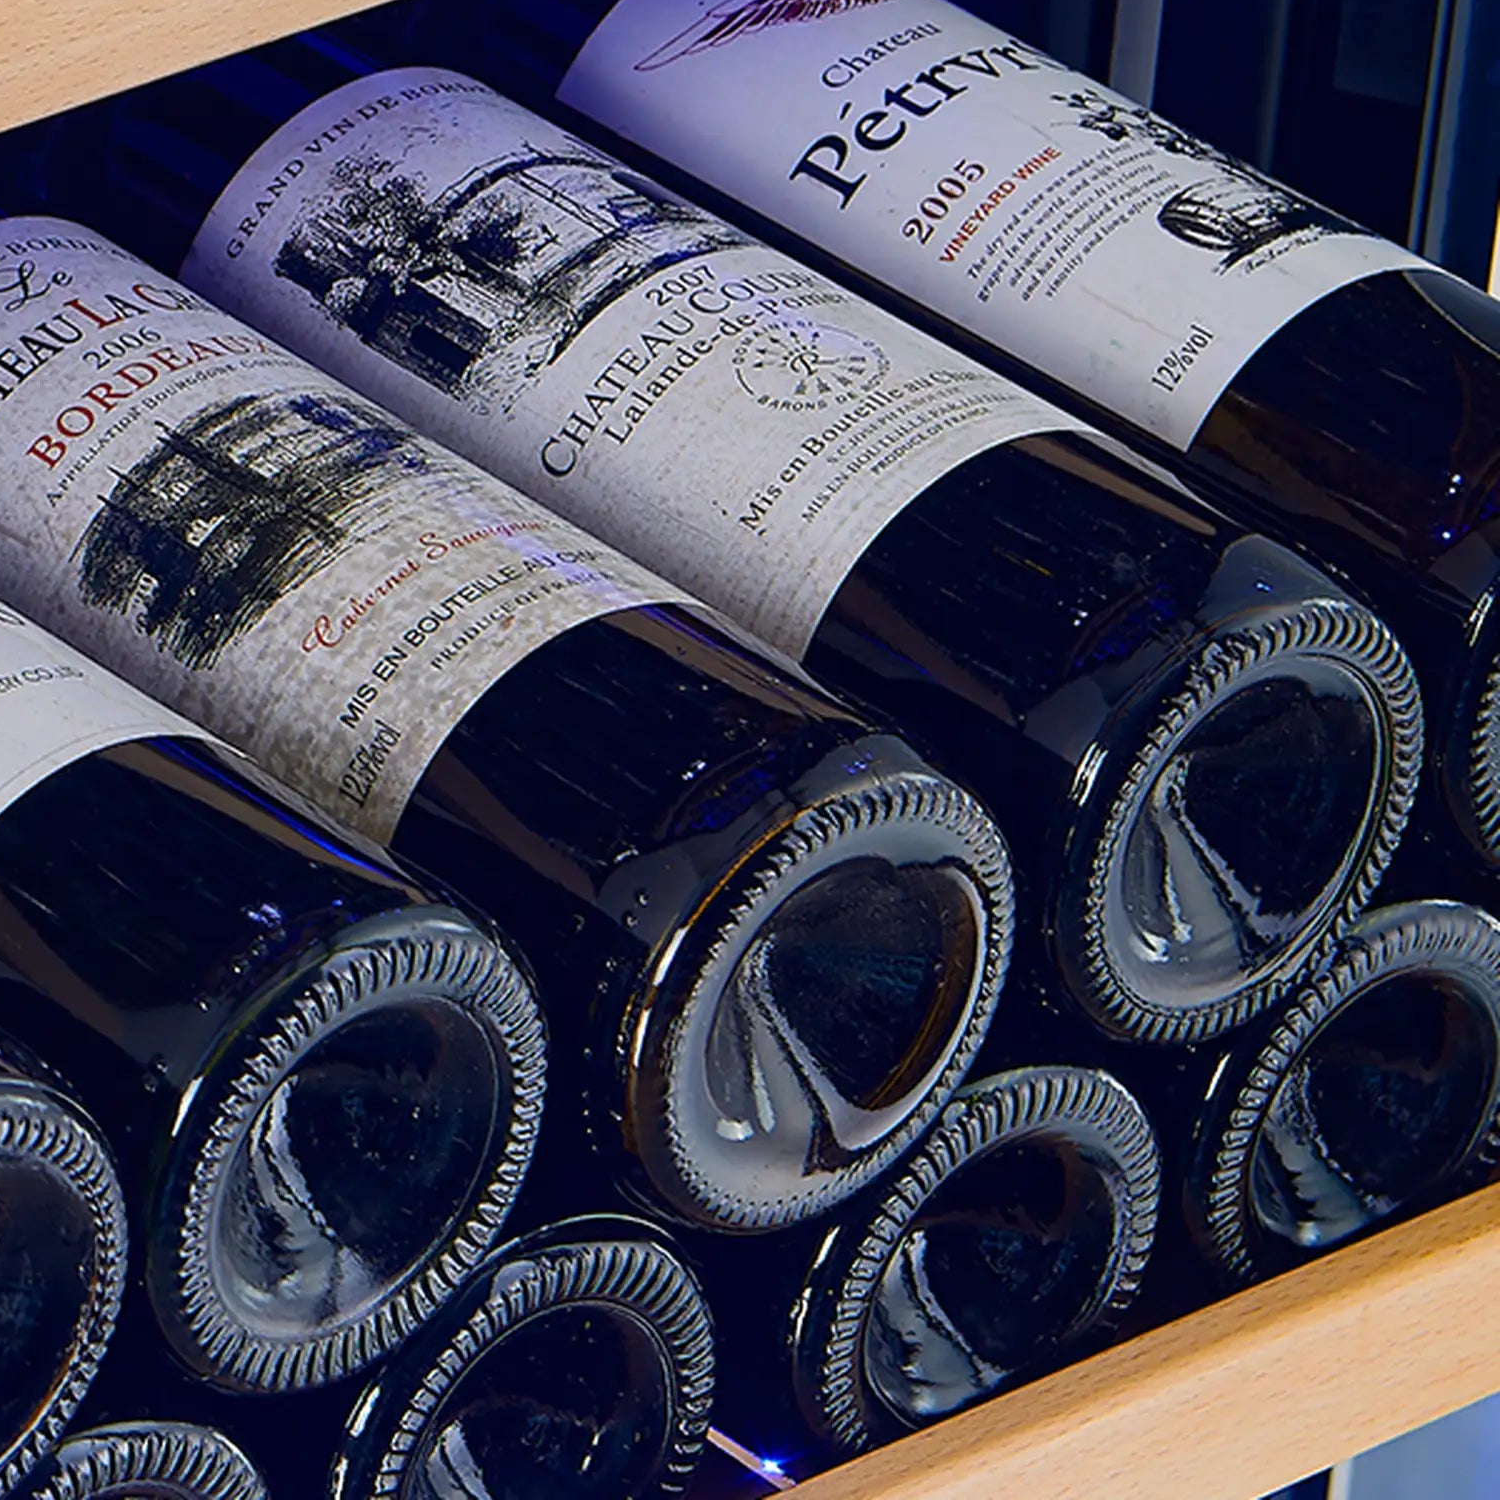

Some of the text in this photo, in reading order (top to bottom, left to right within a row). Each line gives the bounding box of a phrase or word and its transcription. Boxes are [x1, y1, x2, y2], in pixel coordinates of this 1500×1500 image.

[821, 21, 943, 89] Chateau
[225, 94, 399, 260] GRAND VIN DE
[901, 157, 987, 246] 2005
[937, 145, 1062, 264] VINEYARD WINE
[966, 255, 988, 280] The
[986, 235, 1005, 258] dry
[1002, 214, 1021, 236] red
[1020, 192, 1044, 215] wine
[1017, 226, 1035, 245] the
[1082, 234, 1104, 255] and
[1102, 214, 1131, 238] long
[644, 264, 716, 308] 2007
[1021, 276, 1041, 301] and
[82, 325, 162, 370] 2006
[1150, 322, 1215, 393] 12%vol
[25, 333, 268, 472] BORDEAUX
[539, 308, 696, 480] CHATEAU
[44, 403, 143, 509] APPELLATION
[739, 480, 784, 531] Mis
[779, 454, 808, 485] en
[800, 387, 904, 456] Bouteille
[801, 488, 831, 525] MIS
[827, 471, 850, 494] EN
[301, 520, 552, 653] Cabernet Sauvignon
[338, 552, 556, 730] MIS EN BOUTEILLE AU
[429, 603, 517, 671] PRODUCE
[517, 591, 541, 607] OF
